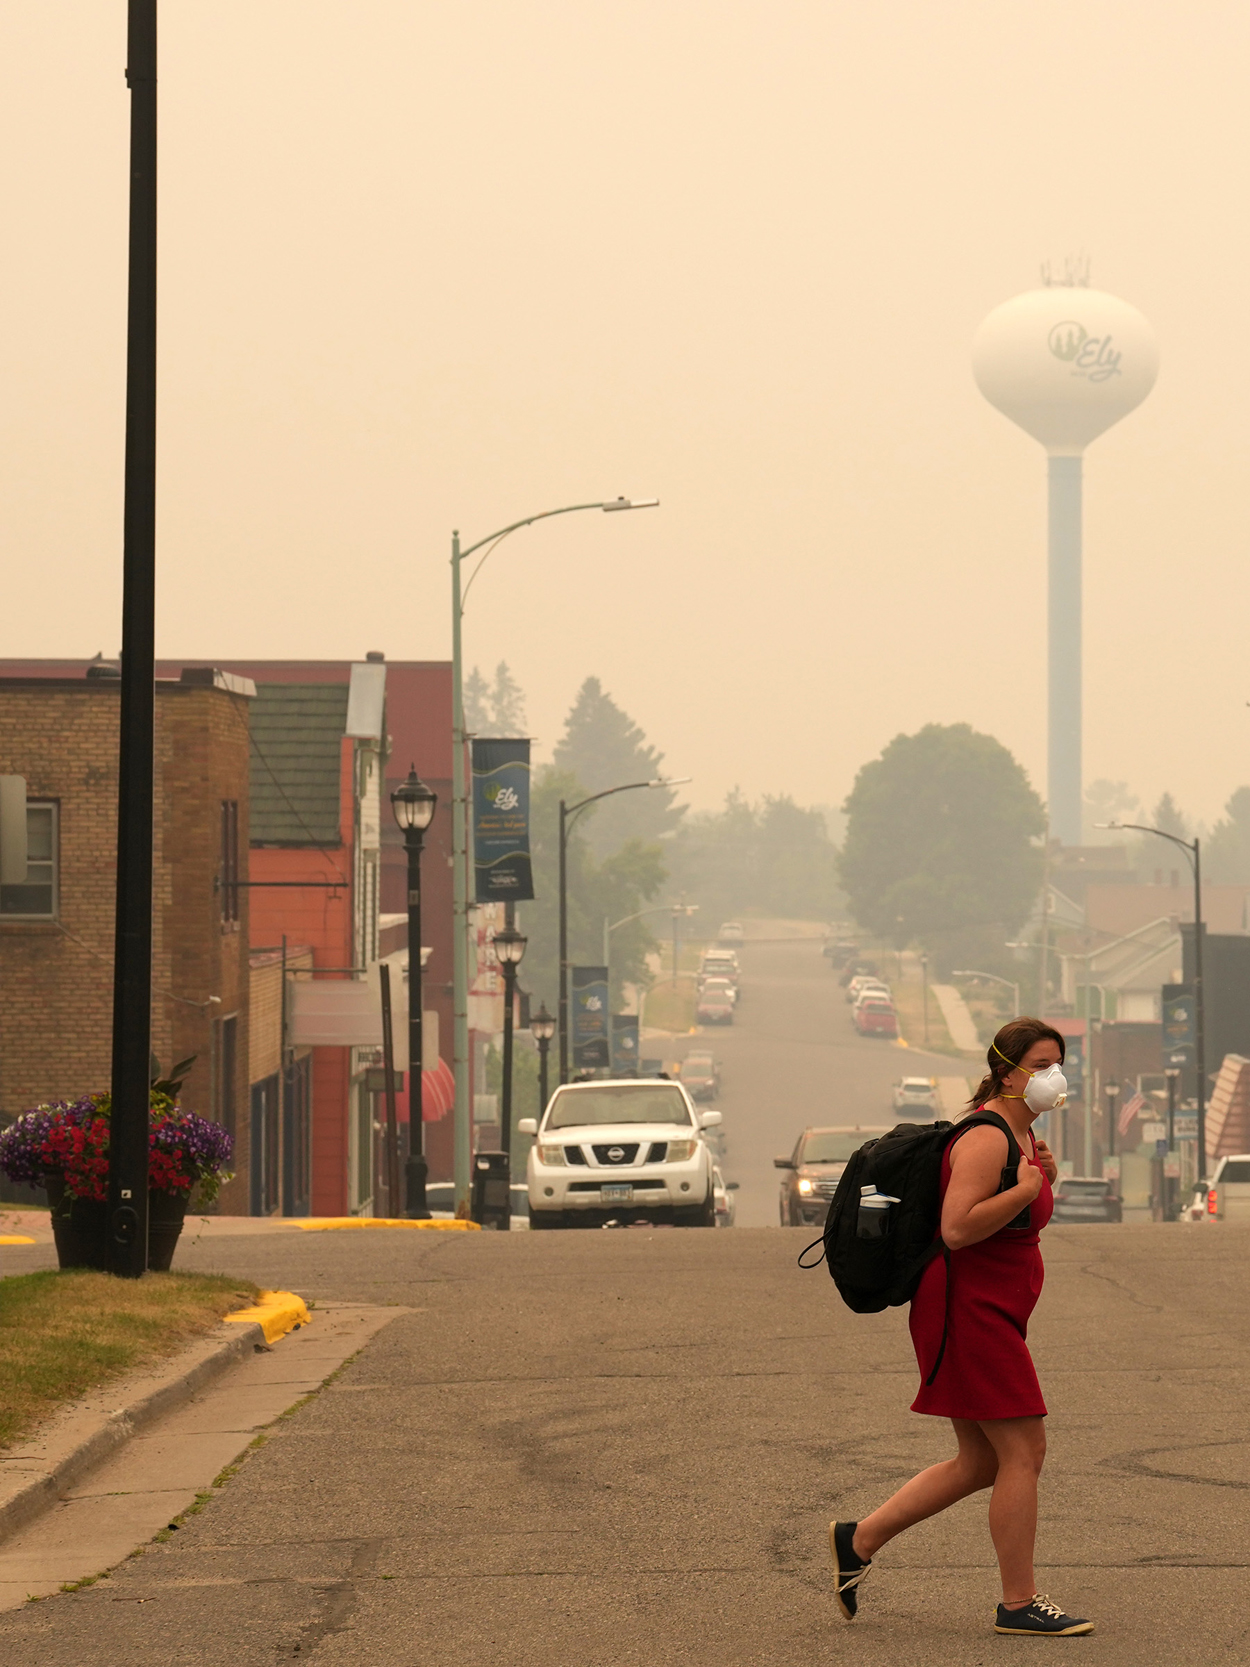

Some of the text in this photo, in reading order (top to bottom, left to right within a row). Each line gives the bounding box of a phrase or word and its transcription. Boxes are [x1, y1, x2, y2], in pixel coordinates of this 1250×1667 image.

[1076, 334, 1122, 382] Ely
[495, 787, 519, 811] Ely
[1027, 1613, 1045, 1624] ASTRAL
